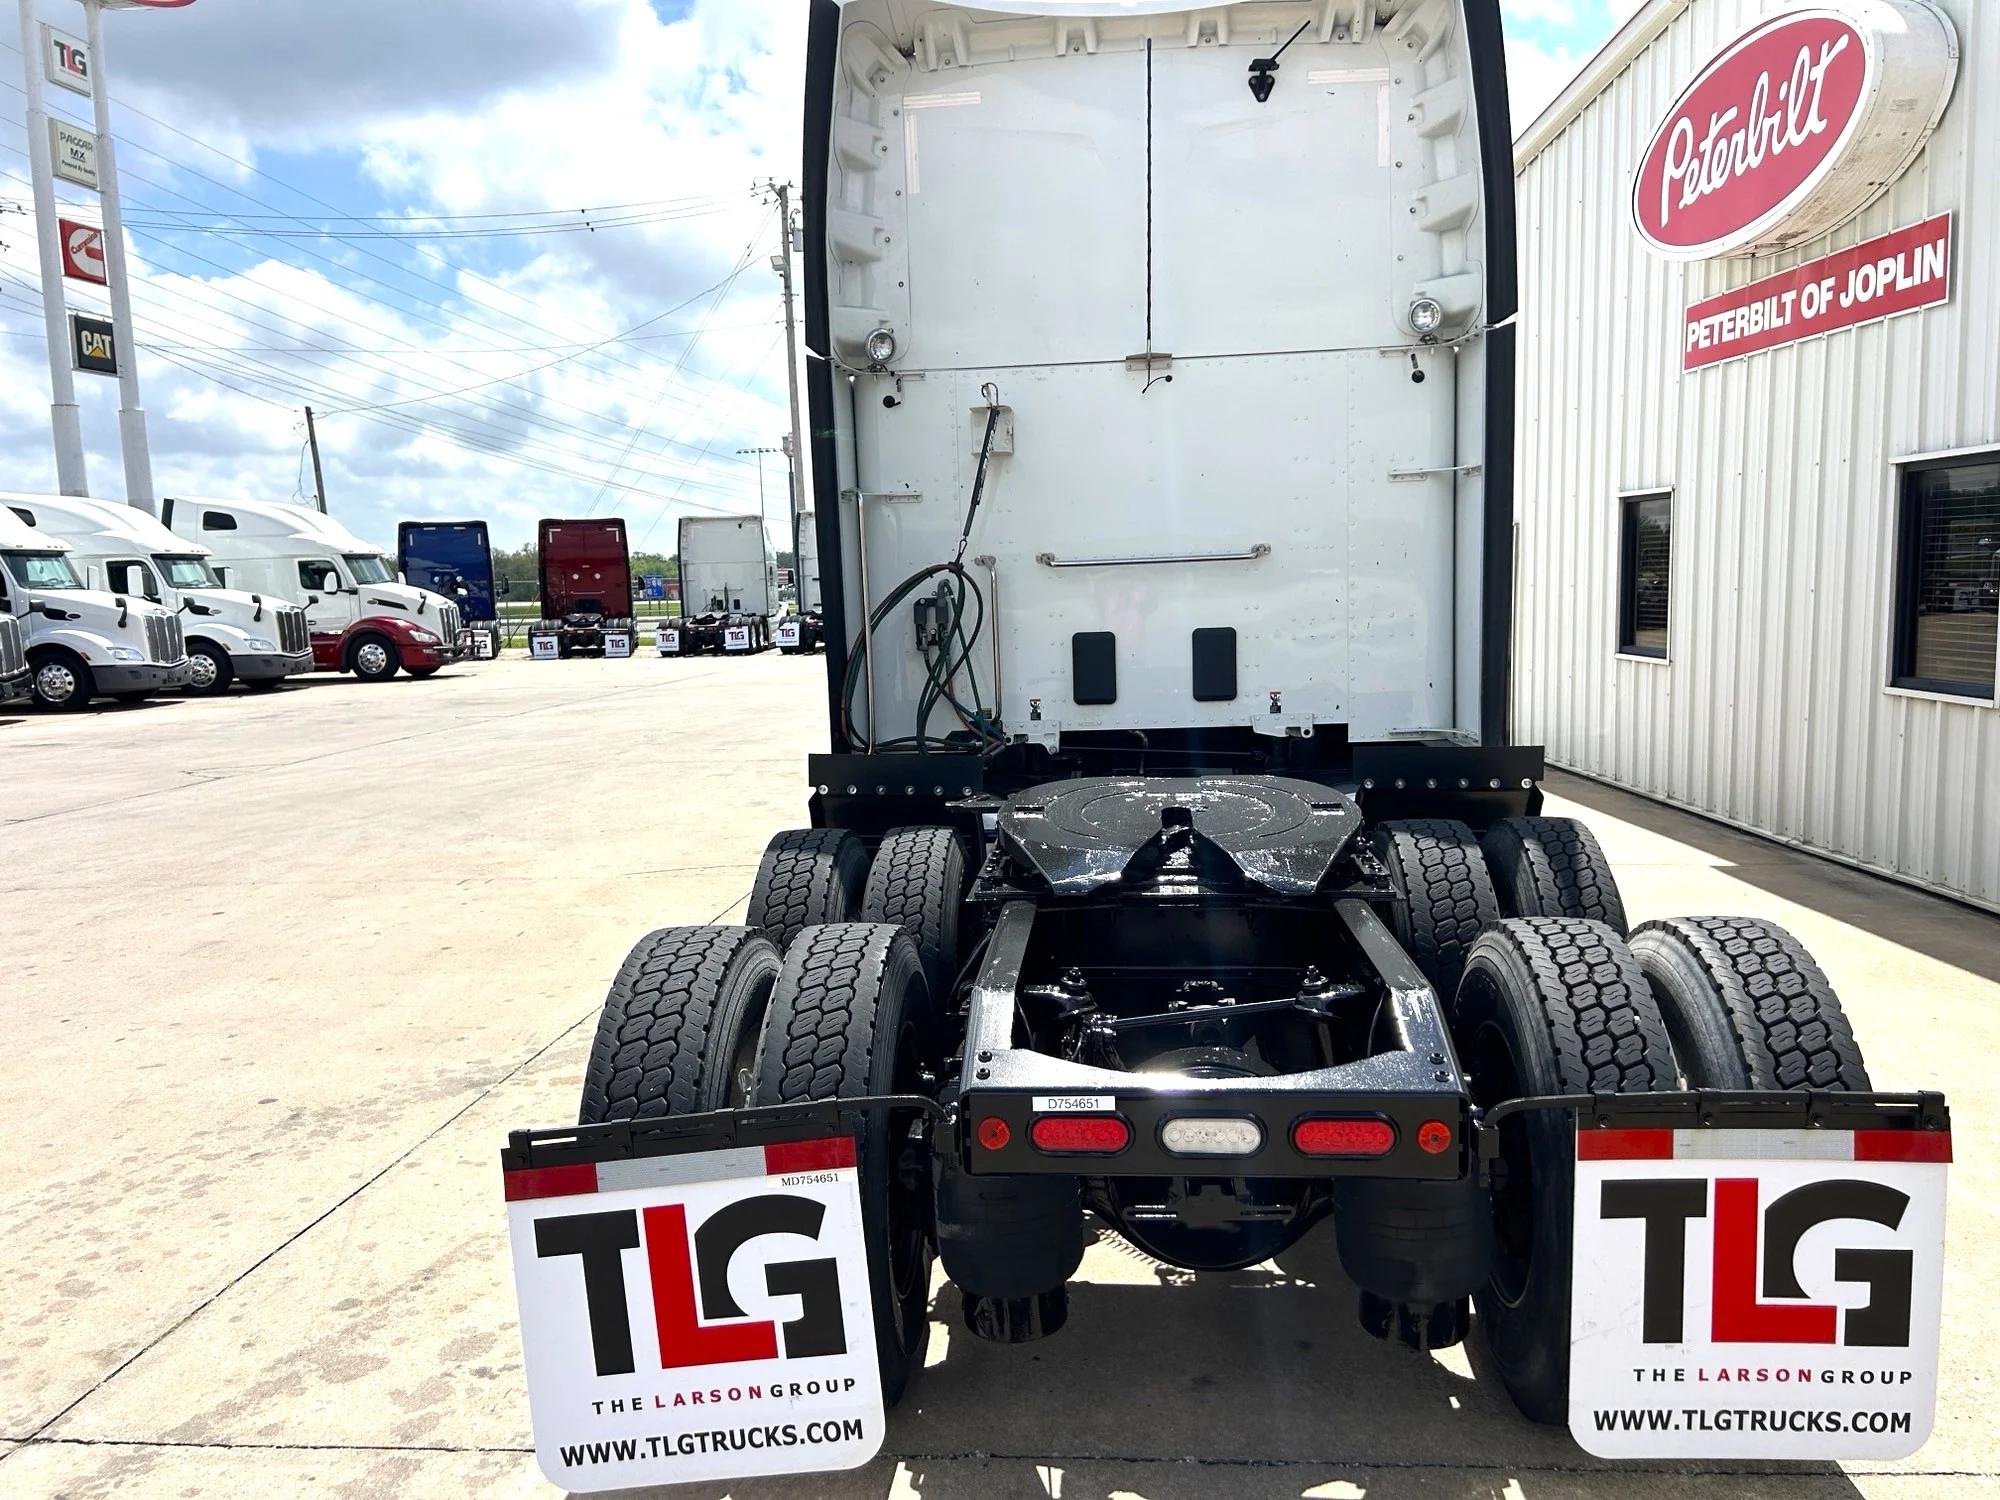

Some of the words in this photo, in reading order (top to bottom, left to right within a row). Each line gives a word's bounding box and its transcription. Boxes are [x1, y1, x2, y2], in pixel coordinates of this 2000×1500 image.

[53, 39, 88, 77] TLG
[1661, 33, 1849, 228] Peterbilt
[60, 131, 93, 152] PACCAR
[70, 147, 86, 161] MX
[1686, 289, 1798, 353] PETERBILT
[1800, 276, 1836, 320] OF
[1840, 239, 1945, 309] JOPLIN
[81, 330, 112, 360] CAT
[660, 633, 675, 643] TLG
[729, 631, 745, 641] TLG
[780, 628, 796, 638] TLG
[537, 641, 554, 651] TLG
[609, 639, 625, 649] TLG
[1048, 1098, 1099, 1109] D754651
[781, 1173, 839, 1187] MD754651
[1600, 1178, 1914, 1347] TLG
[533, 1194, 848, 1377] TLG
[1633, 1368, 1686, 1382] THE
[592, 1397, 644, 1415] THE
[1593, 1409, 1912, 1434] WWW.TLGTRUCKS.COM
[559, 1419, 864, 1468] WWW.TLGTRUCKS.COM
